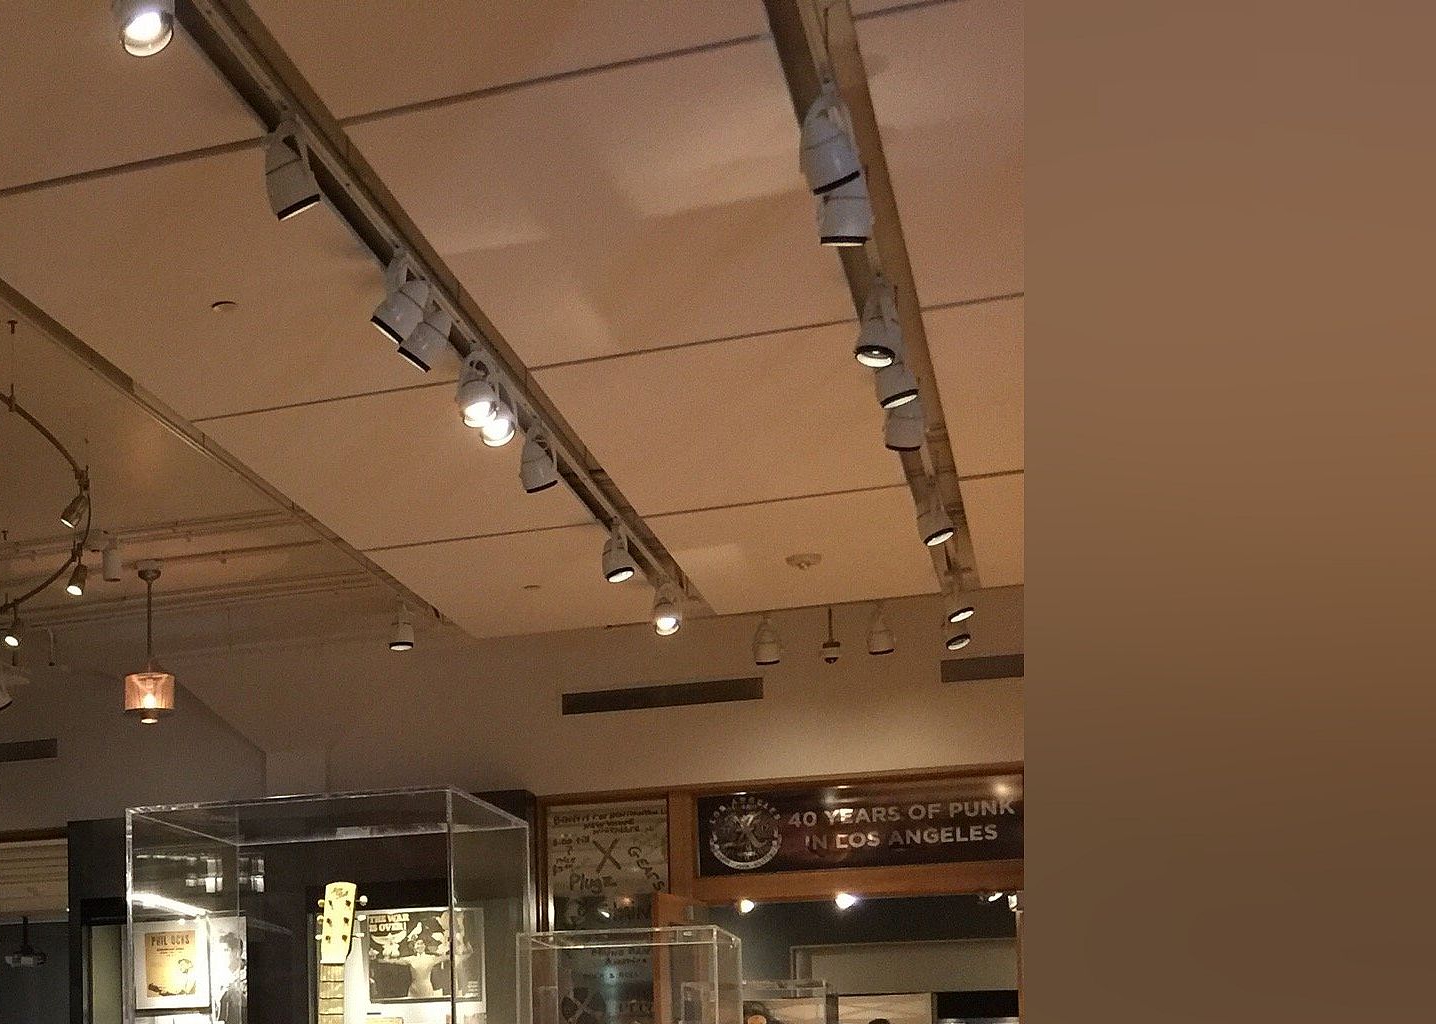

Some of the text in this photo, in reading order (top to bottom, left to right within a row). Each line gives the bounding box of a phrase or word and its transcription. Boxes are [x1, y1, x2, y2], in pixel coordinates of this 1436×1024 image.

[788, 799, 1015, 828] 40 YEARS OF PUNK
[804, 824, 998, 850] IN LOS ANGELES
[387, 912, 410, 923] WAR
[150, 935, 168, 946] PHIL
